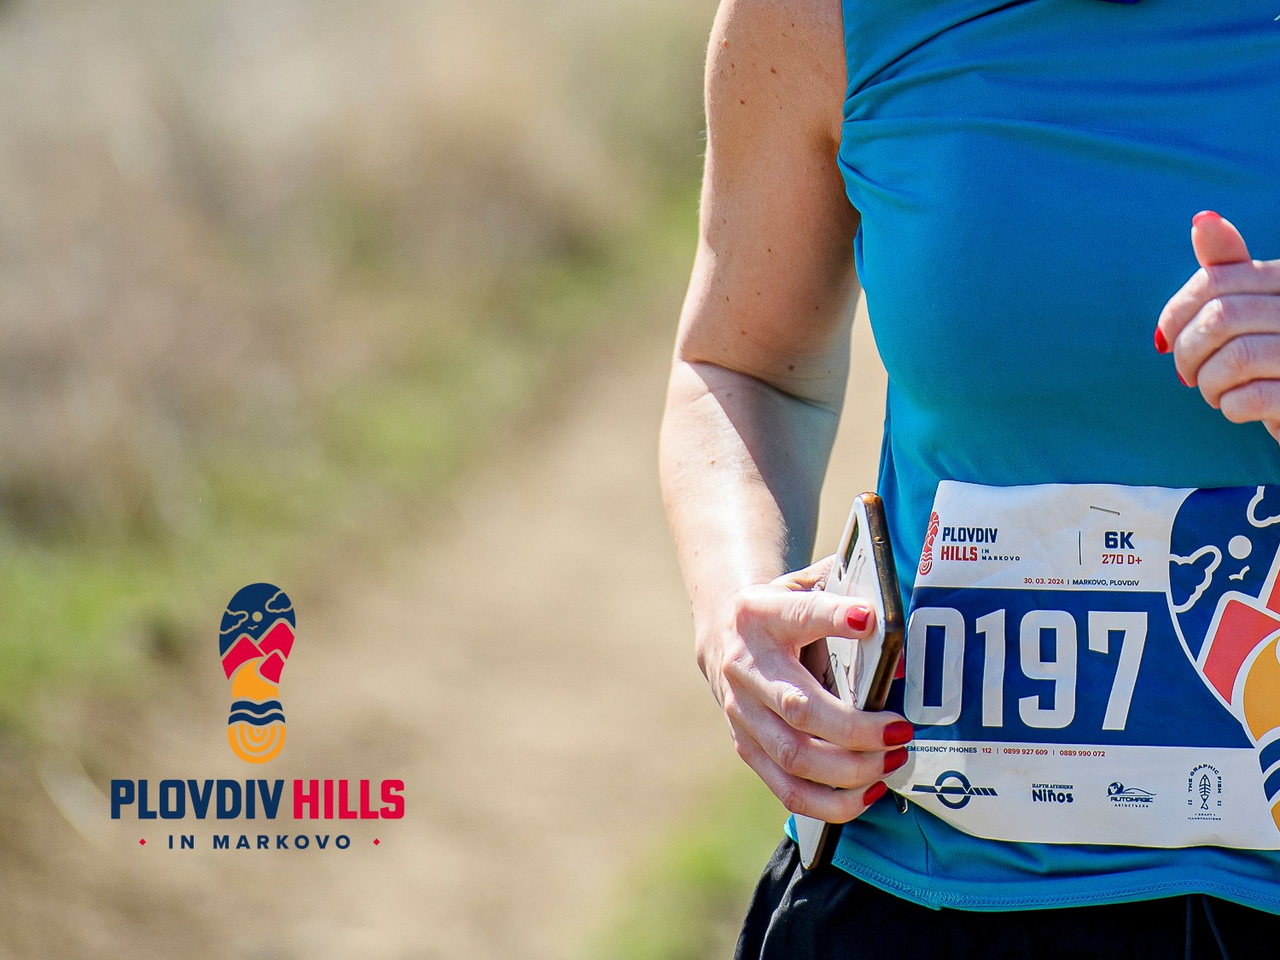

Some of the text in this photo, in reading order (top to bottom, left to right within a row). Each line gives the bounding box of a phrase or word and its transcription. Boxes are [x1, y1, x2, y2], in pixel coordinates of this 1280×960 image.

[942, 527, 998, 543] PLOVDIV
[1104, 531, 1135, 549] 6K
[940, 545, 978, 561] HILLS
[1102, 554, 1142, 565] 270 D+
[903, 606, 1148, 731] 0197
[907, 745, 948, 753] EMERGENCY
[949, 746, 977, 754] PHONES
